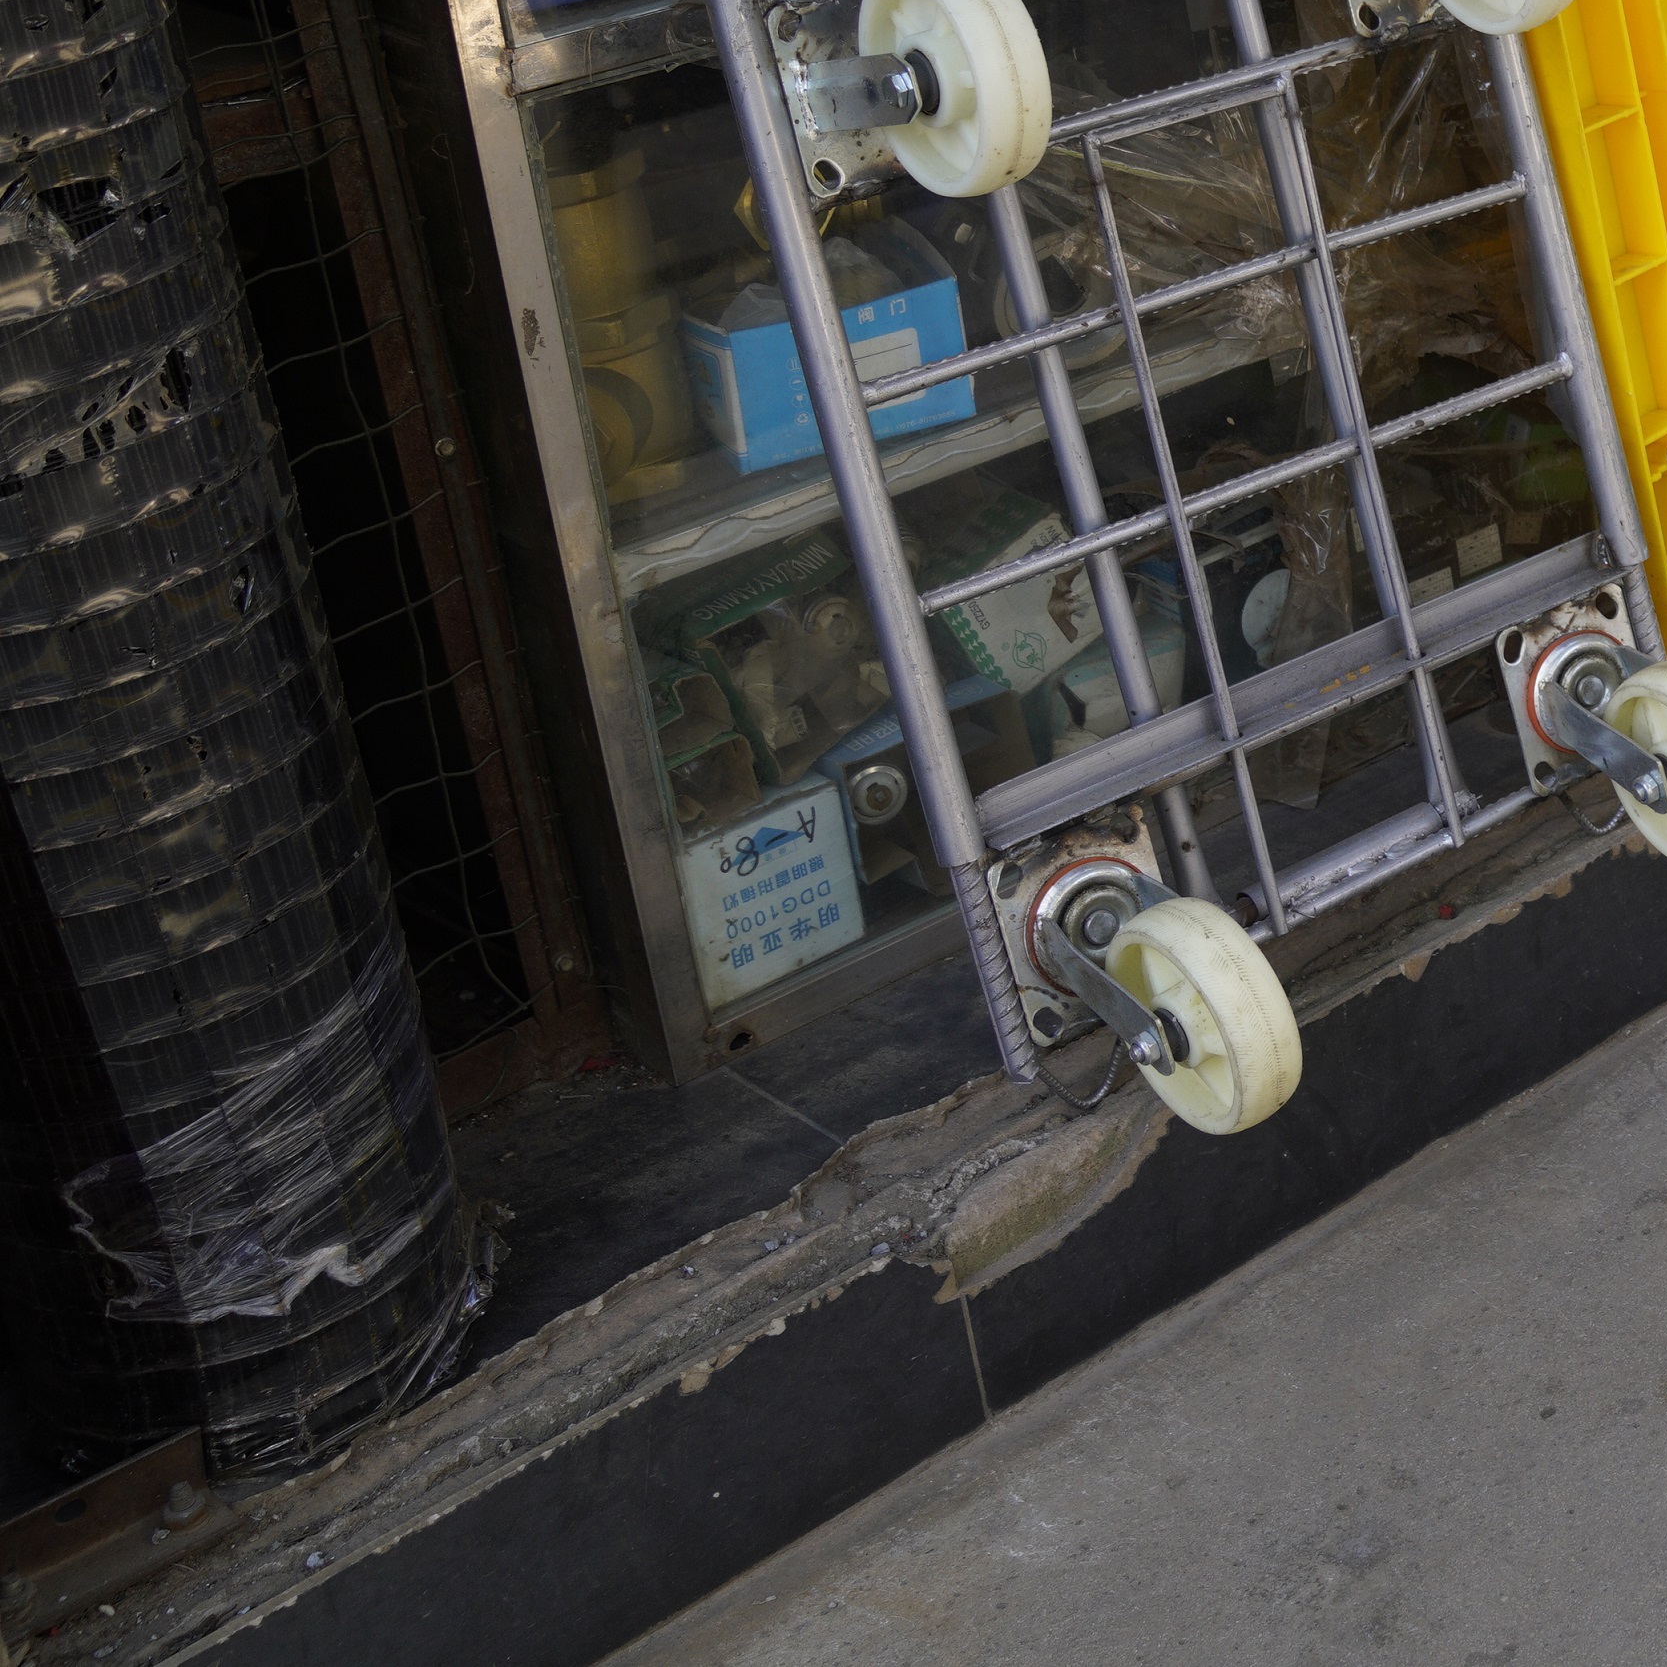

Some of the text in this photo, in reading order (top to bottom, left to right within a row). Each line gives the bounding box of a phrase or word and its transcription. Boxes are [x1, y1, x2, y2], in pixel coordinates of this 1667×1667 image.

[857, 299, 907, 325] 阀门
[726, 880, 831, 940] DDG1000
[730, 903, 841, 970] 明华亚明
